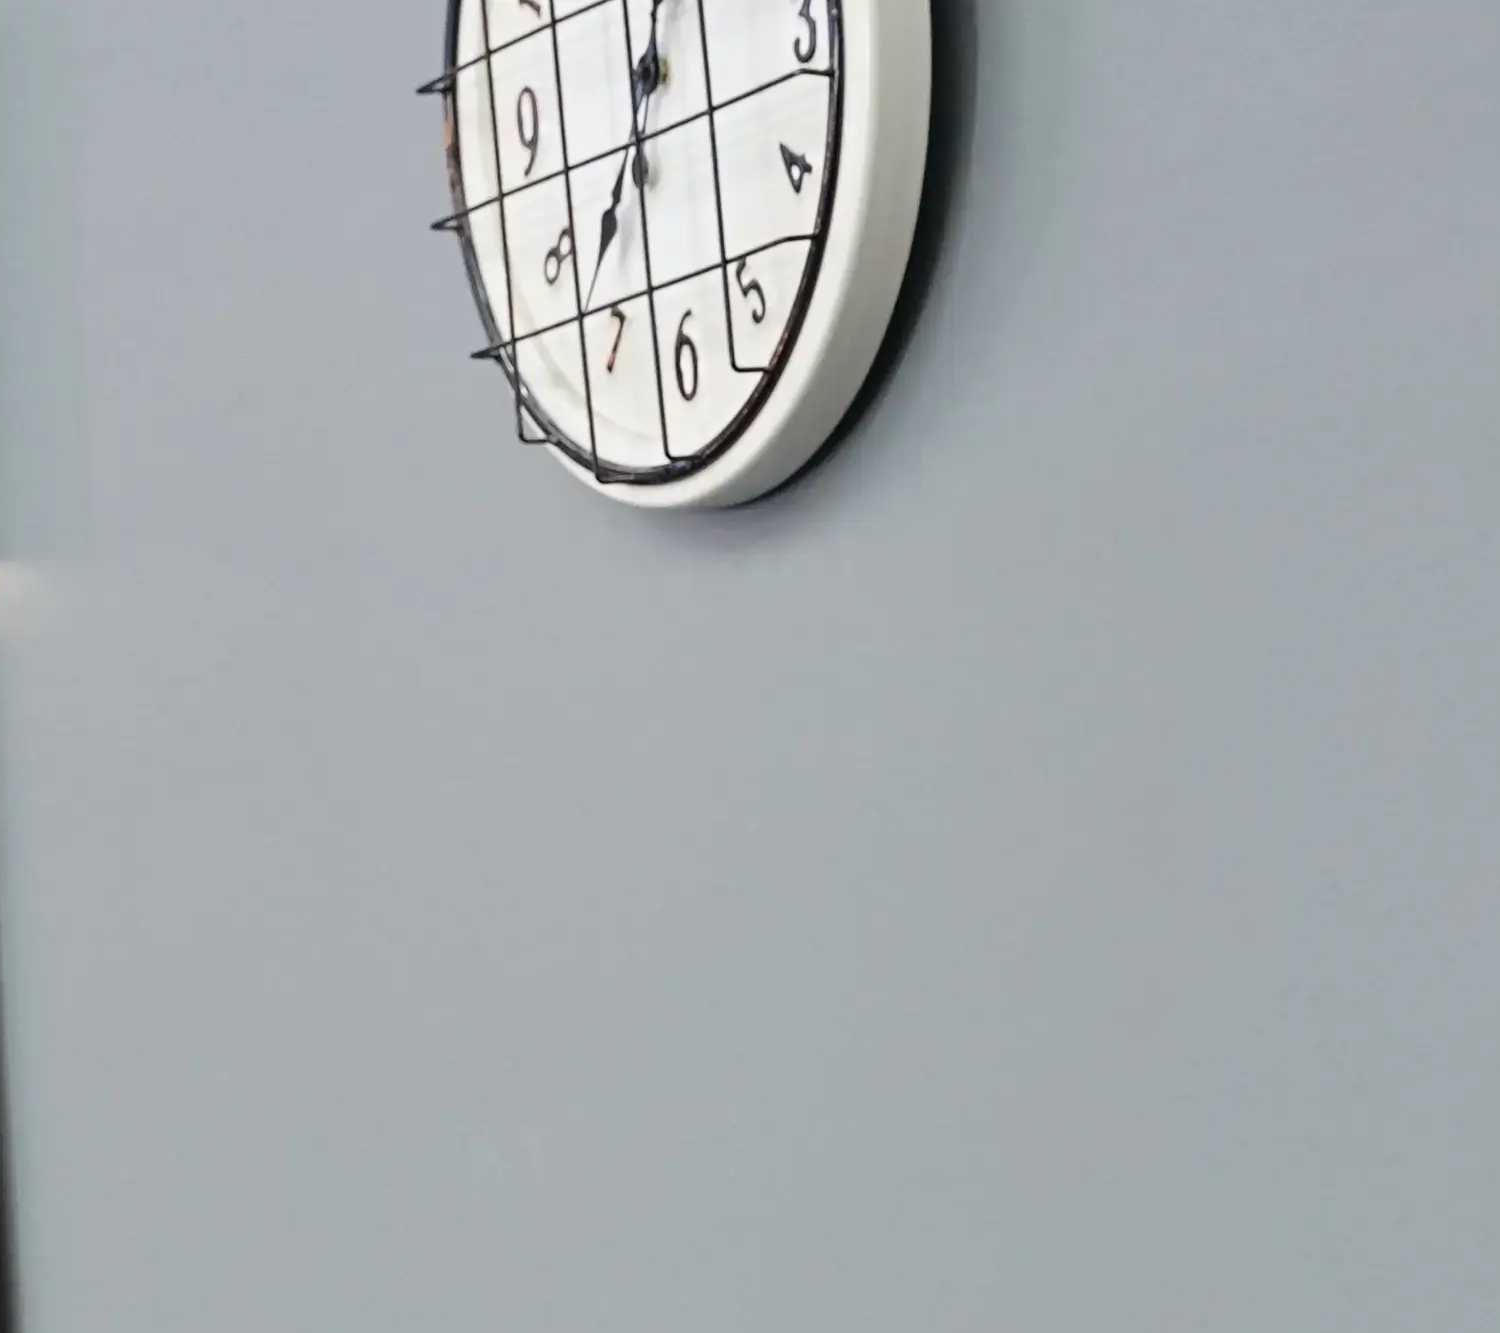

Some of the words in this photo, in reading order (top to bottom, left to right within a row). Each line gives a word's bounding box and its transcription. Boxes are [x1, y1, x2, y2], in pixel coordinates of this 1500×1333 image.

[518, 87, 538, 176] 9
[780, 144, 812, 194] 4
[544, 227, 573, 285] 8
[735, 257, 765, 324] 5
[605, 305, 626, 373] 7
[675, 310, 698, 401] 6
